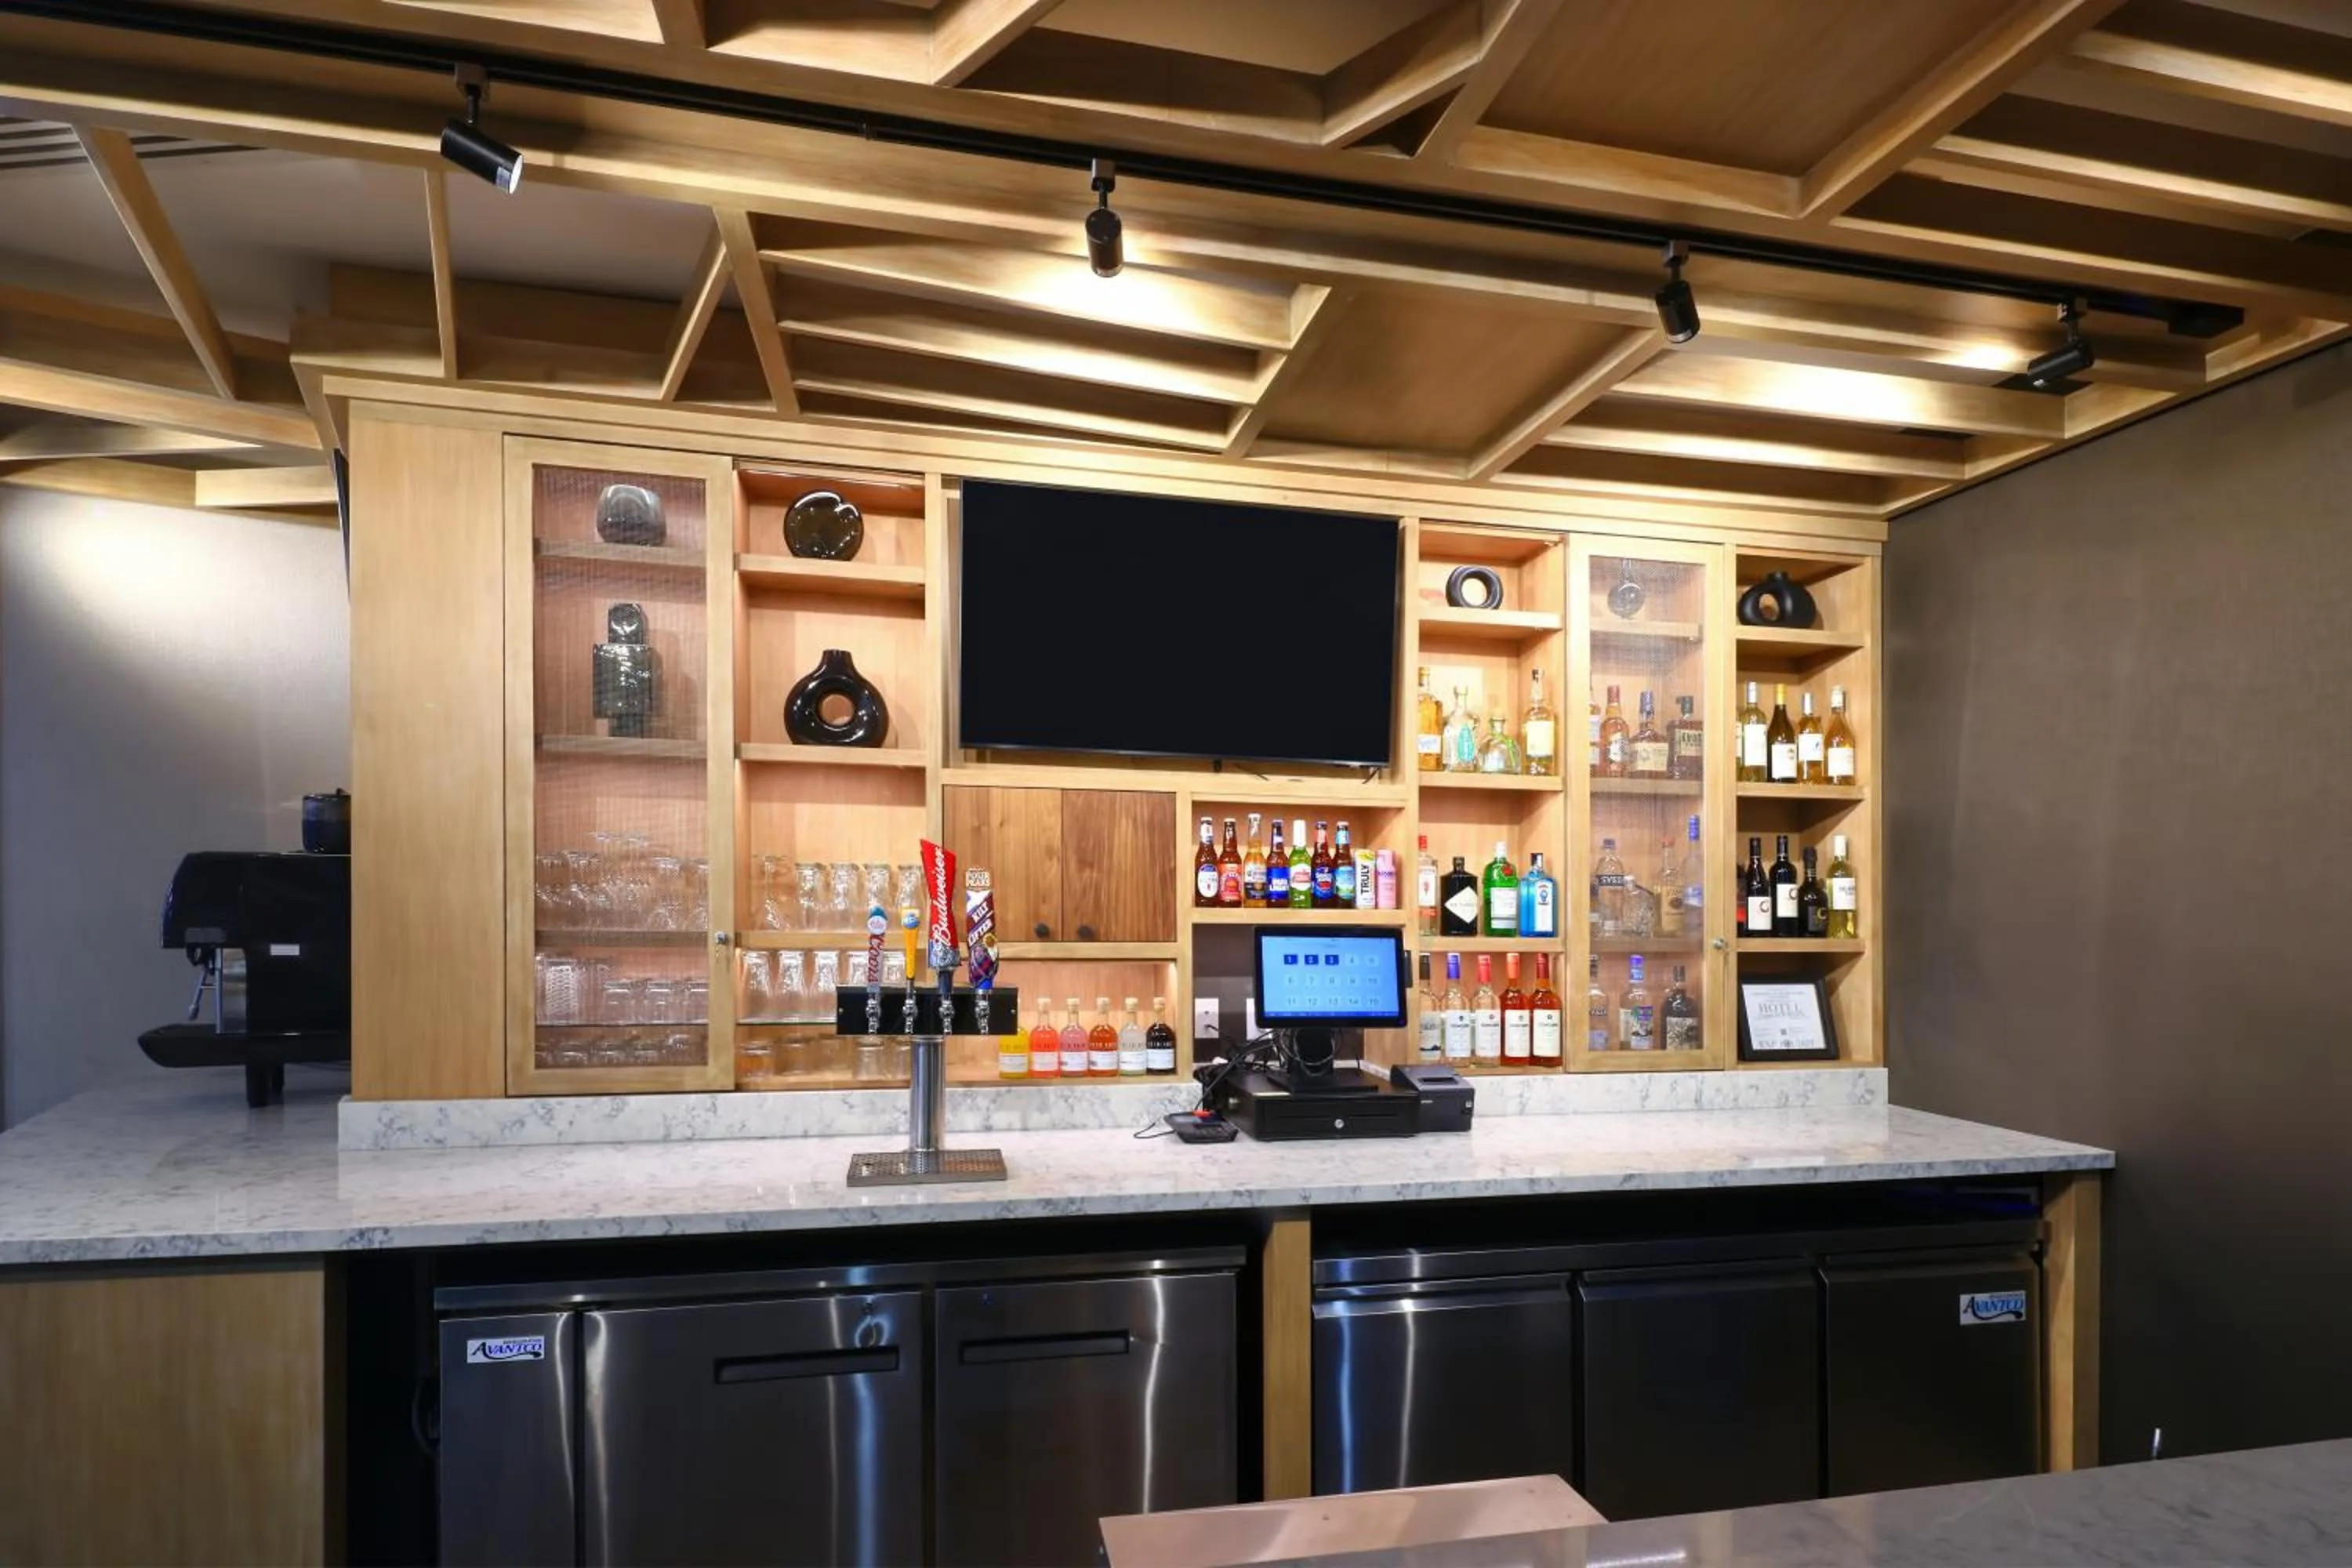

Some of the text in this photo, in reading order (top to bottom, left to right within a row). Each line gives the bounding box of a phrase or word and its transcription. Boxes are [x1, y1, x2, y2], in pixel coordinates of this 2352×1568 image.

[1360, 863, 1370, 895] TRULY
[931, 845, 952, 946] Budweiser
[471, 1341, 543, 1360] AVANTCO
